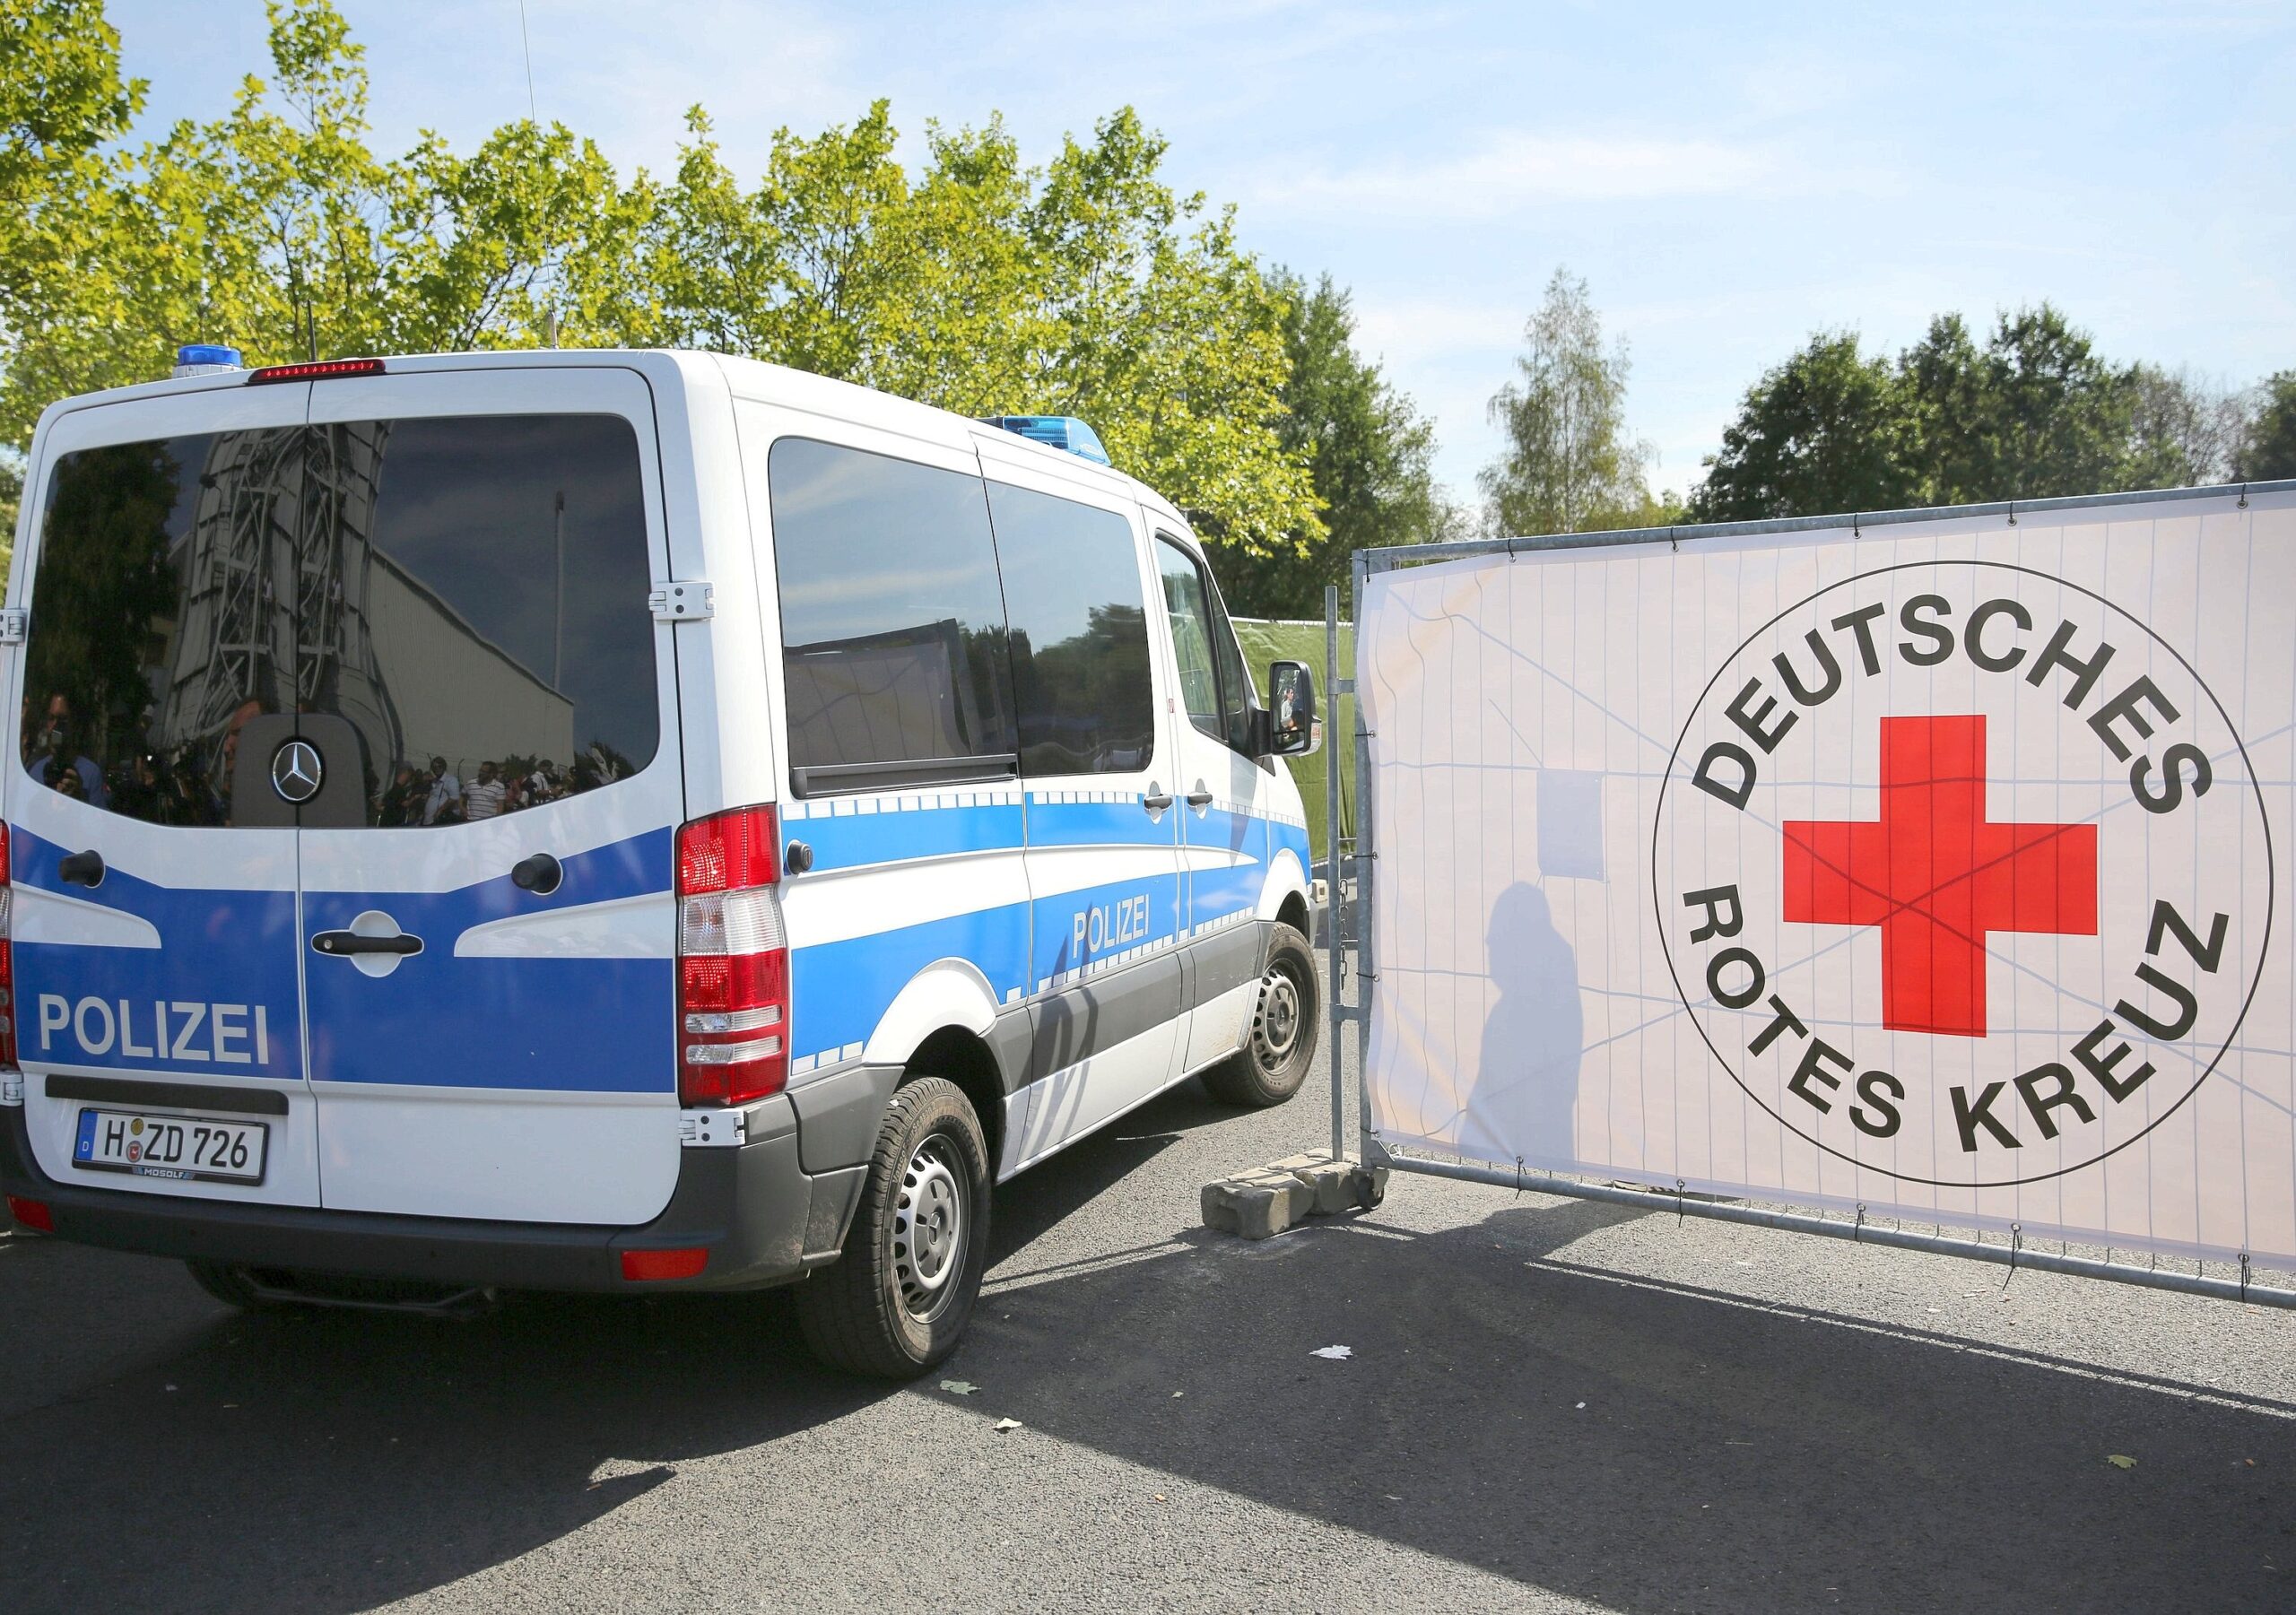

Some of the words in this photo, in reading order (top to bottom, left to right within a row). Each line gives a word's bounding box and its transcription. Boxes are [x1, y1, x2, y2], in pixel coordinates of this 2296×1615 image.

[1692, 595, 2212, 813] DEUTSCHES
[1073, 893, 1149, 959] POLIZEI
[39, 994, 269, 1064] POLIZEI
[1683, 884, 1904, 1138] ROTES
[1950, 899, 2229, 1152] KREUZ
[82, 1141, 89, 1152] D
[105, 1120, 126, 1157] H
[144, 1123, 185, 1163] ZD
[194, 1127, 248, 1168] 726
[144, 1168, 185, 1179] MOSOLF
